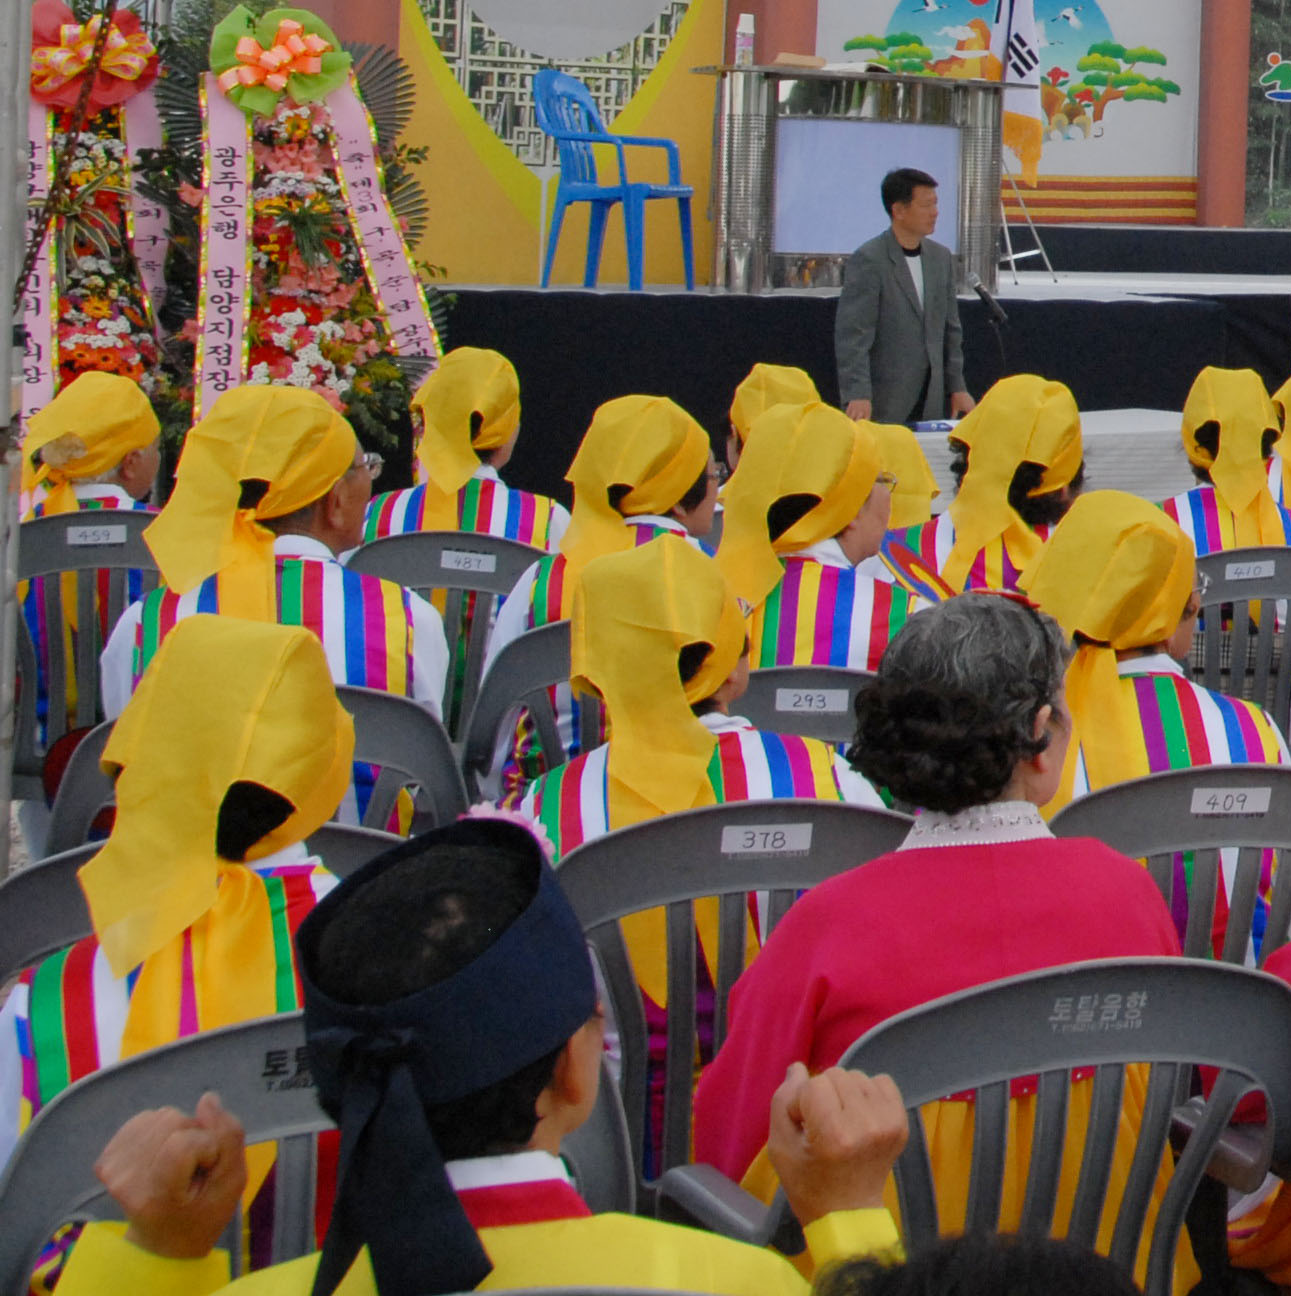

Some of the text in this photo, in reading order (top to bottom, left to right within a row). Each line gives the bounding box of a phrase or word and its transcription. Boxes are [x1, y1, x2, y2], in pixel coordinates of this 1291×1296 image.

[206, 145, 244, 393] 광주은행 담양지점장
[78, 529, 111, 543] 459
[453, 555, 483, 571] 487
[1233, 565, 1263, 578] 410
[792, 694, 827, 710] 293
[1206, 793, 1248, 812] 409
[741, 831, 787, 850] 378
[1047, 990, 1149, 1023] 토탈음향
